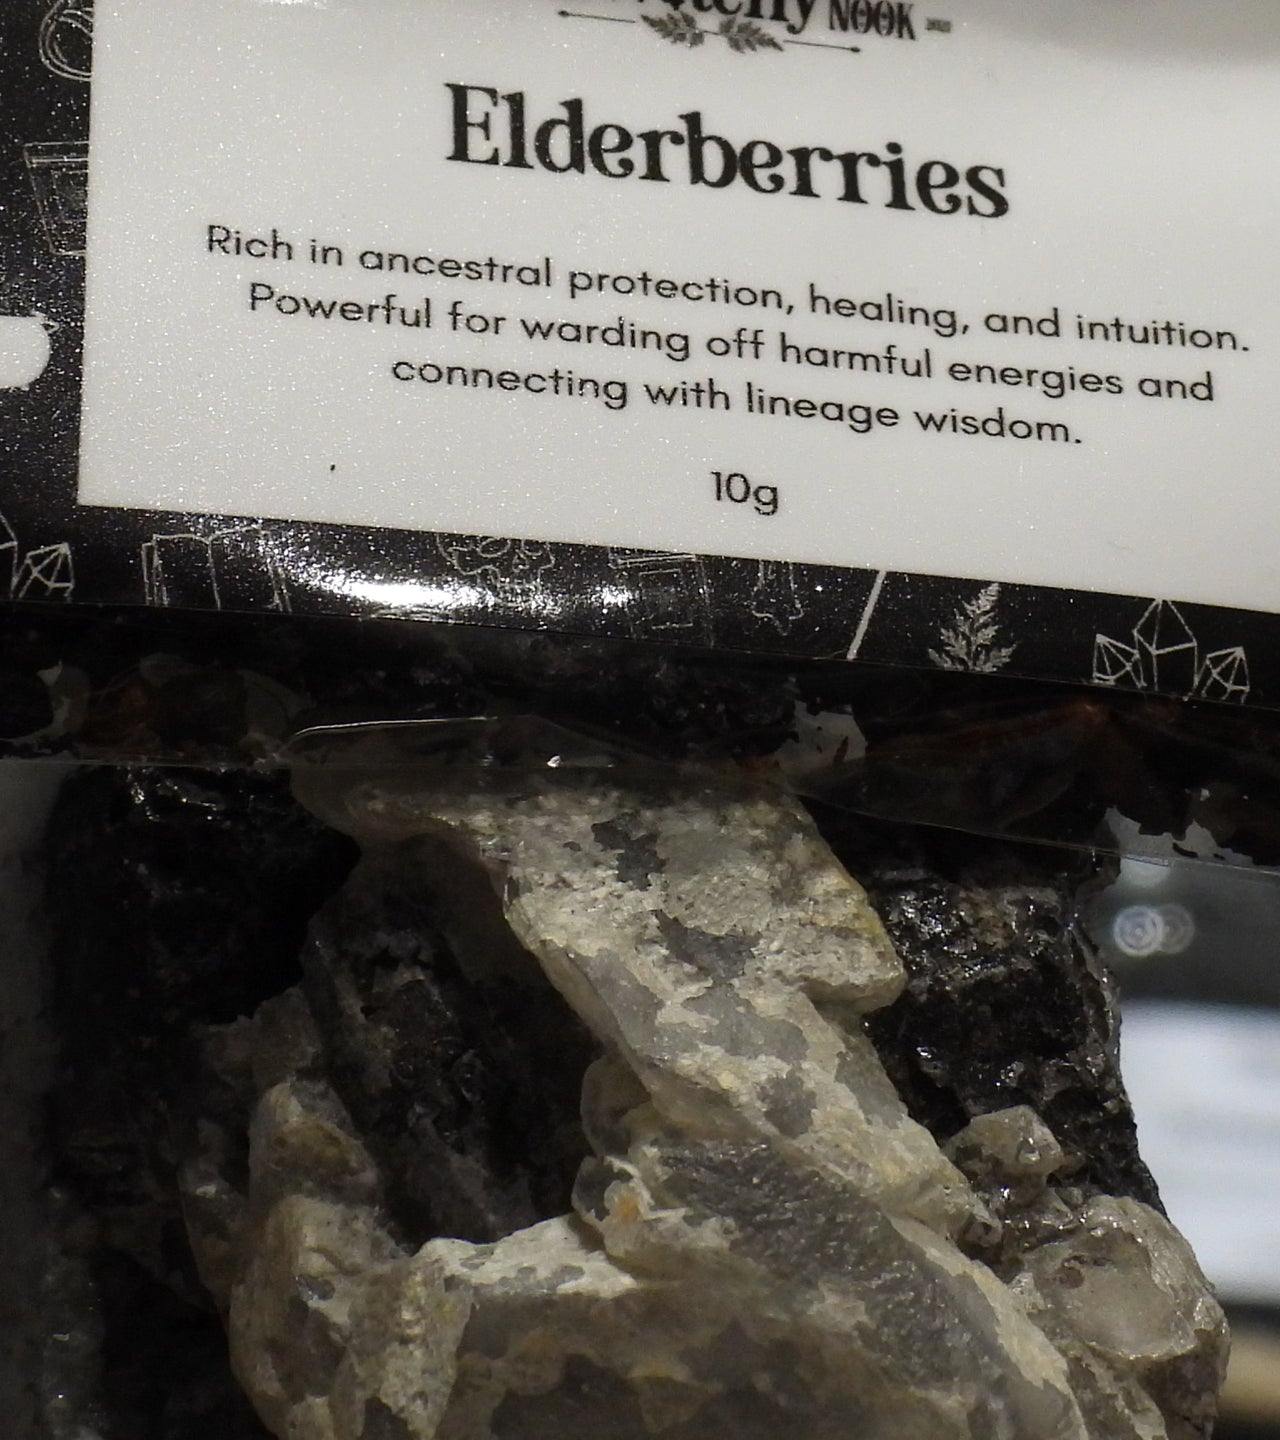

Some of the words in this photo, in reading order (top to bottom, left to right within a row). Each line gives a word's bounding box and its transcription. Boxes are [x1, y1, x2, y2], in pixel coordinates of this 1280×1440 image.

[442, 82, 1010, 219] Elderberries
[206, 223, 294, 262] Rich
[308, 238, 344, 267] in
[358, 247, 553, 290] ancestral
[567, 269, 796, 317] protection,
[808, 282, 972, 337] healing,
[983, 306, 1062, 339] and
[1076, 314, 1251, 353] intuition.
[249, 281, 433, 329] Powerful
[447, 299, 507, 336] for
[519, 315, 691, 363] warding
[705, 327, 766, 360] off
[779, 331, 933, 380] harmful
[947, 361, 1125, 400] energies
[1137, 370, 1216, 402] and
[390, 359, 630, 411] connecting
[642, 376, 732, 411] with
[746, 381, 902, 435] lineage
[912, 406, 1084, 446] wisdom.
[709, 470, 779, 517] 10g
